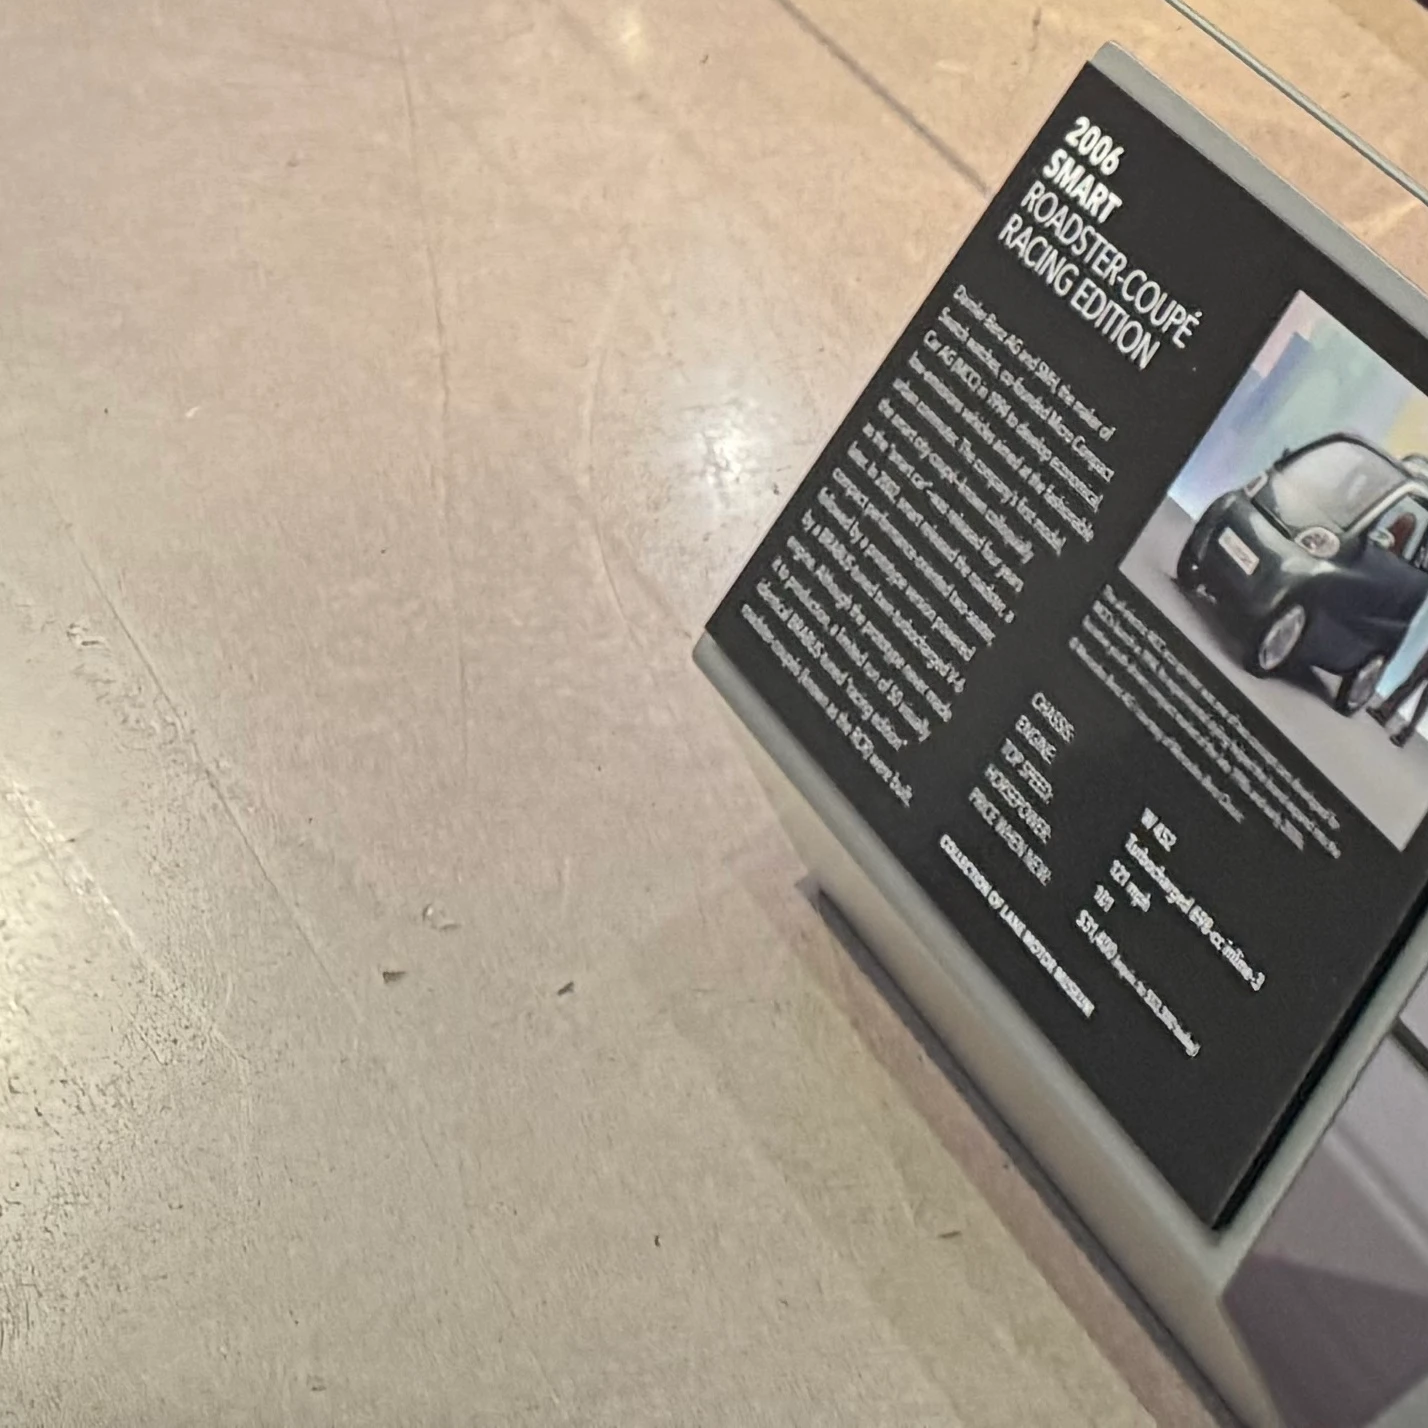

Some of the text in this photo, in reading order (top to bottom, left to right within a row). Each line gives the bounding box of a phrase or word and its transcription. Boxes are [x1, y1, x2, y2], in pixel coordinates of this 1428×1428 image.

[1042, 147, 1123, 224] SMART
[1063, 115, 1125, 176] 2006
[997, 212, 1161, 371] RACING EDITION
[1020, 180, 1203, 349] ROADSTER-COUPÉ
